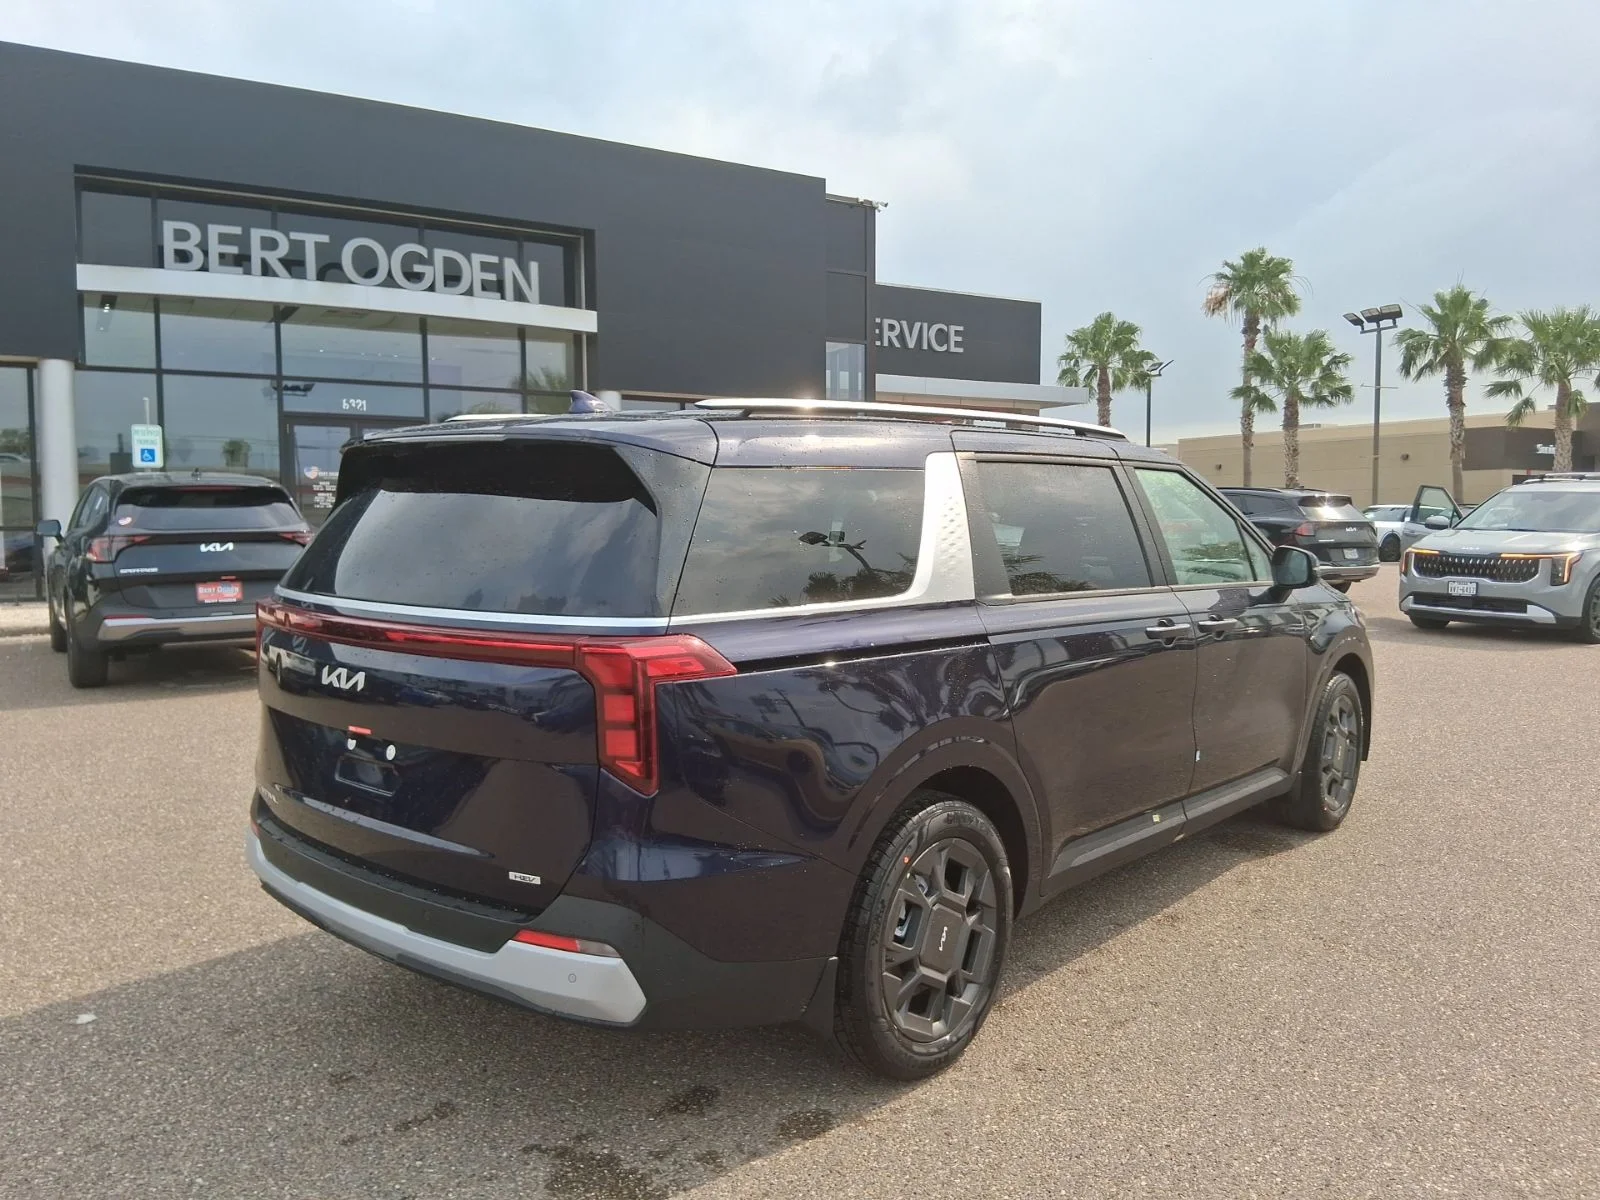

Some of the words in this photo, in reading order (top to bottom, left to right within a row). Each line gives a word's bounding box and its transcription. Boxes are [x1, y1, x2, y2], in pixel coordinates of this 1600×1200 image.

[162, 219, 331, 281] BERT
[340, 236, 541, 304] OGDEN
[199, 542, 235, 553] KIA
[321, 664, 366, 693] KIA
